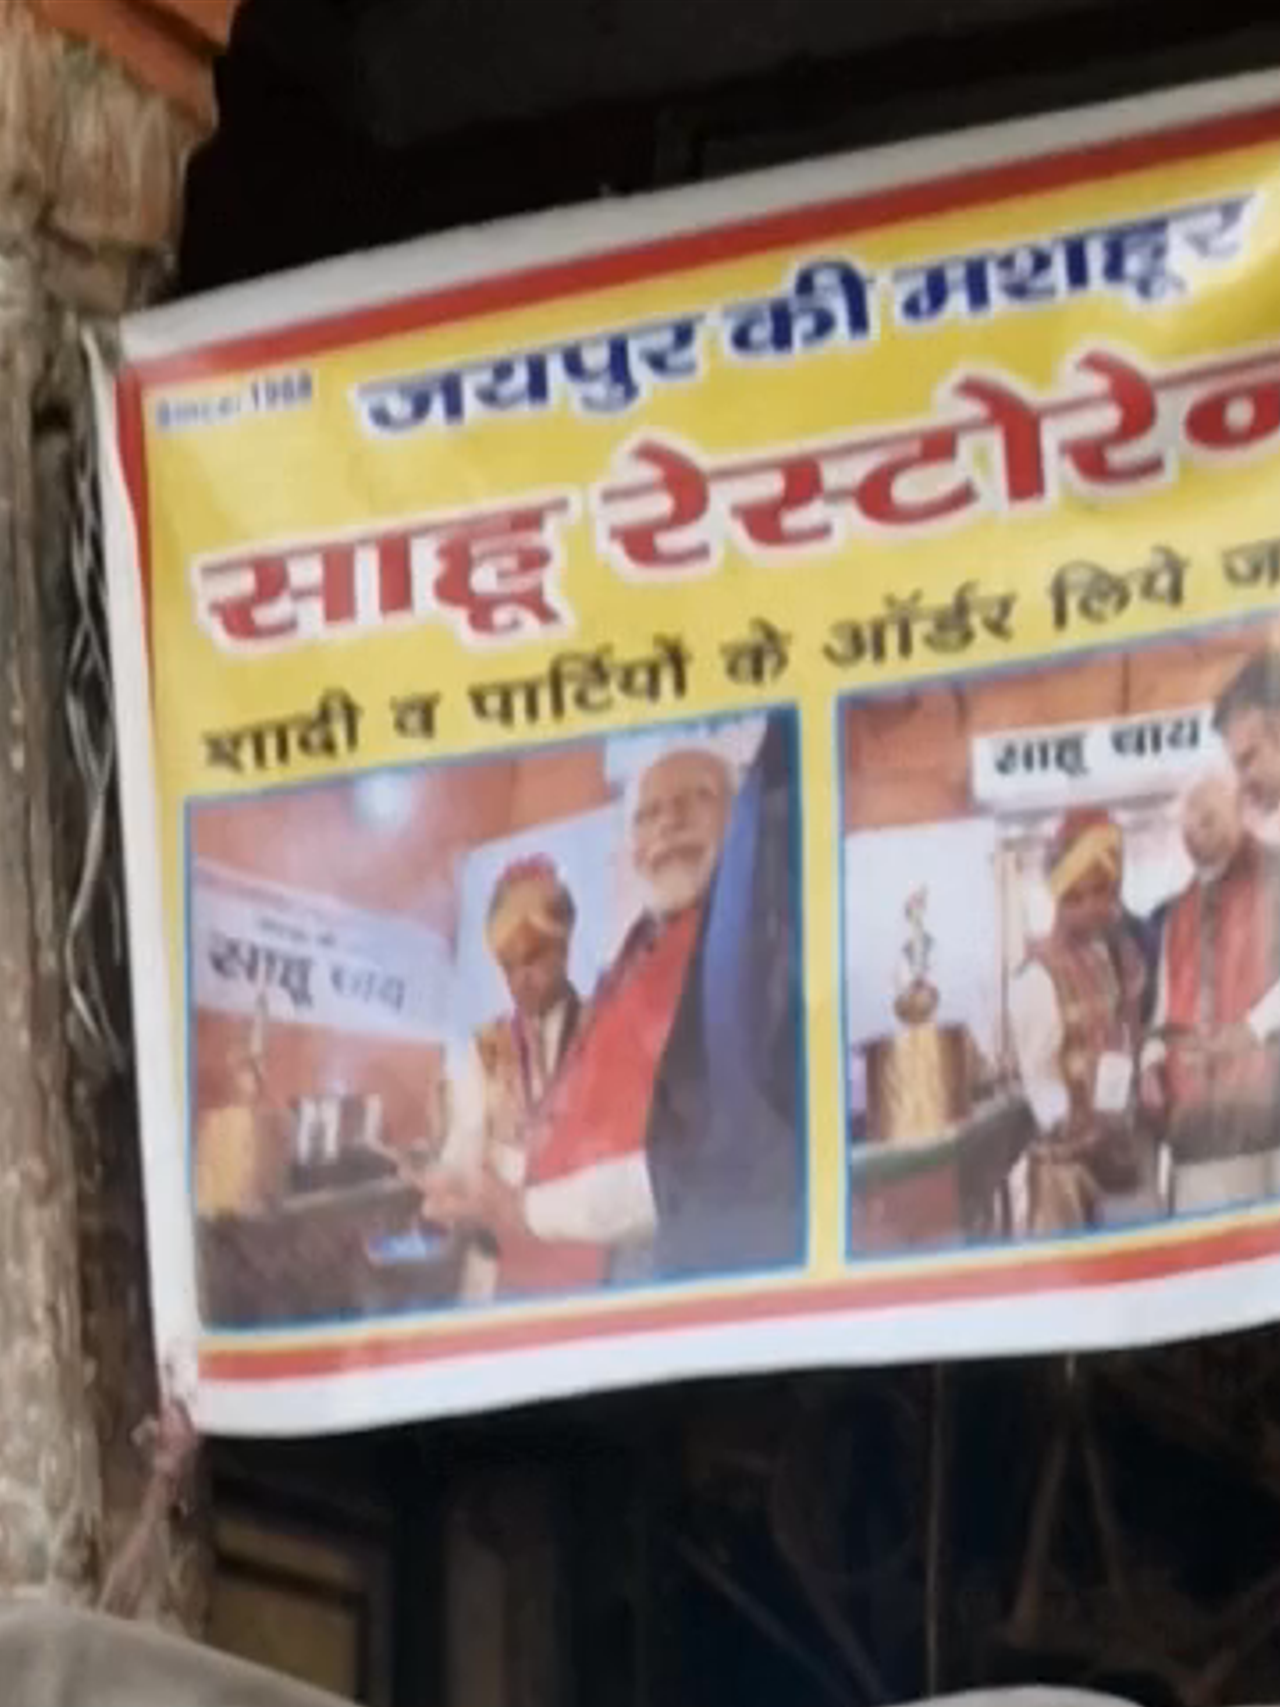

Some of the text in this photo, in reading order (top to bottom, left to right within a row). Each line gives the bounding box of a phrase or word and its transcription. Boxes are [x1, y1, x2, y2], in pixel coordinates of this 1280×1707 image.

[360, 195, 1254, 432] जयपुर की मशहूर
[202, 498, 566, 644] साहू
[204, 690, 362, 772] शादी
[392, 693, 440, 739] व
[721, 617, 791, 685] के
[823, 580, 1018, 668] ऑर्डर
[1050, 545, 1191, 631] लिये
